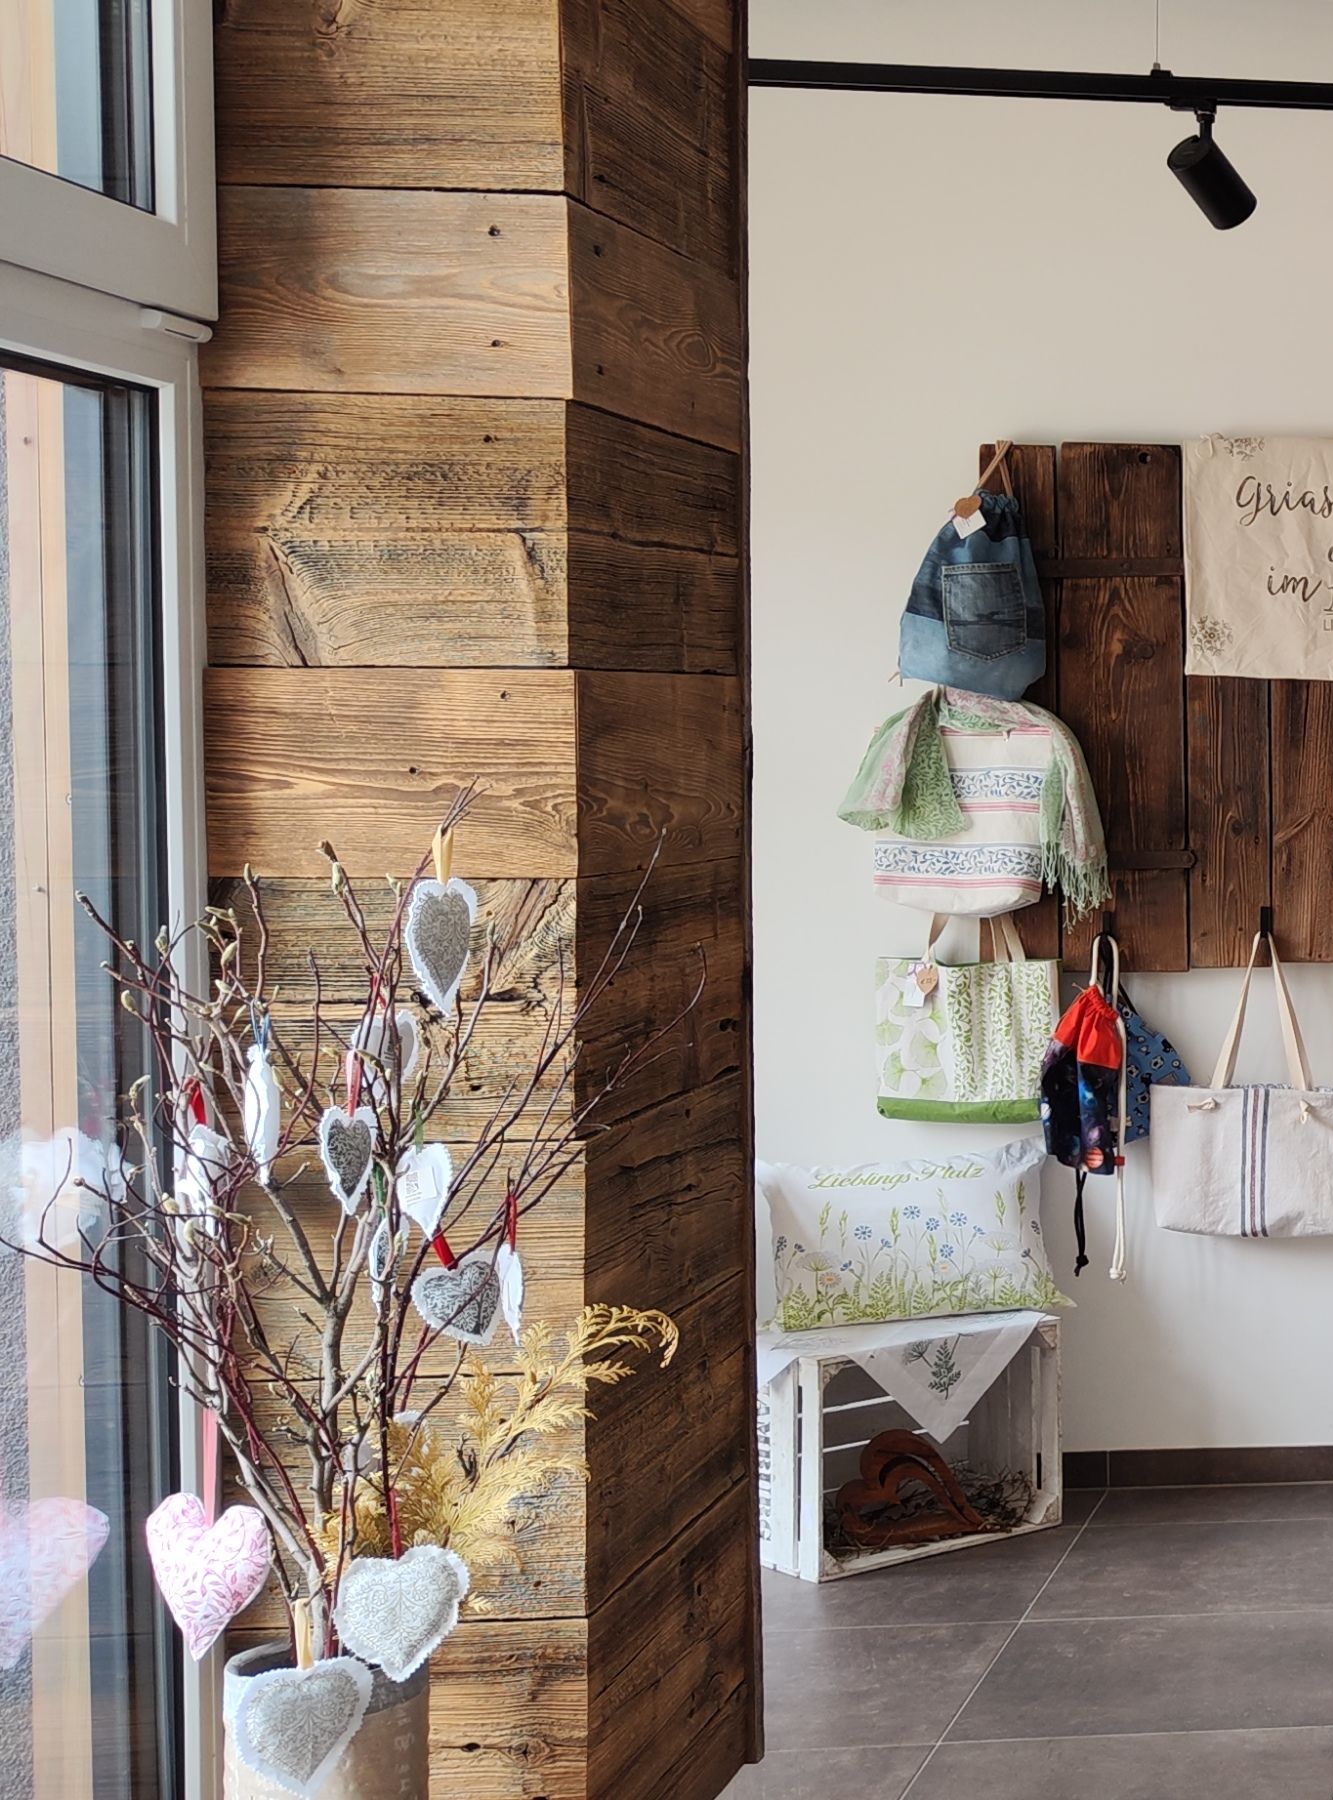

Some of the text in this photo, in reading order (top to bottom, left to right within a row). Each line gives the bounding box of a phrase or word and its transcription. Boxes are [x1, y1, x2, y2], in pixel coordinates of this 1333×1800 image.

[1267, 566, 1322, 602] im
[807, 1162, 984, 1191] Lieblings Platz
